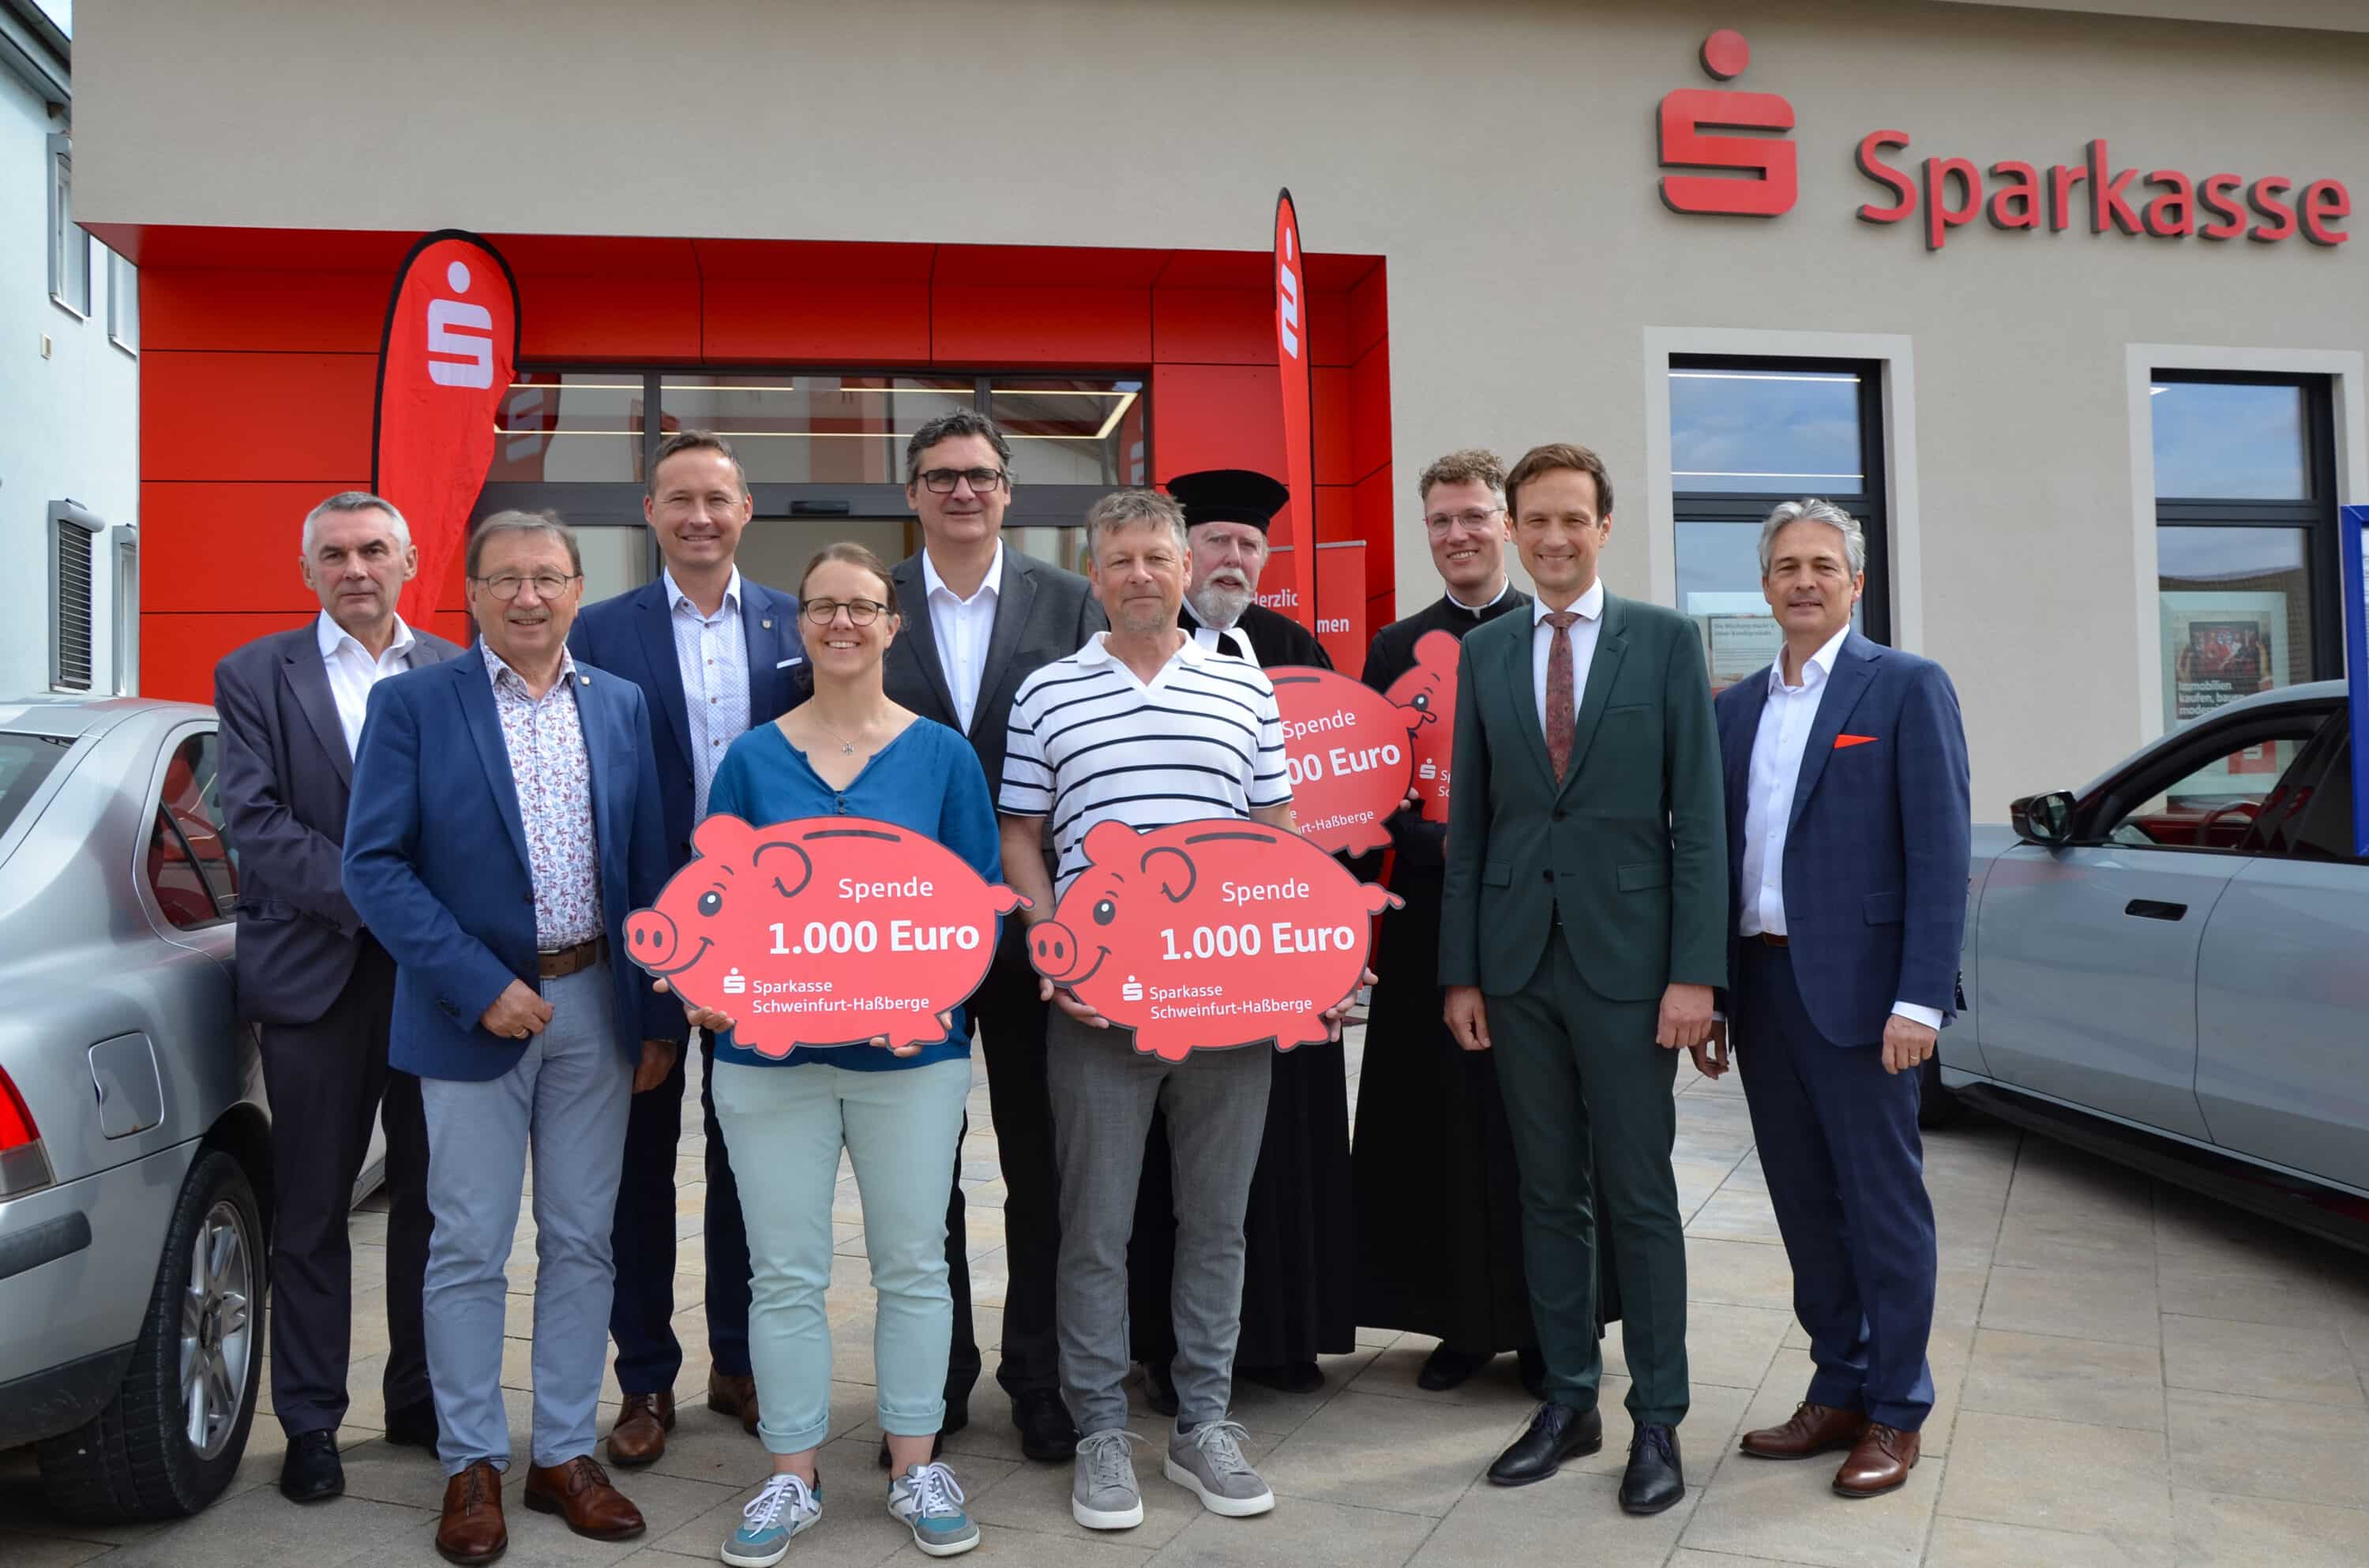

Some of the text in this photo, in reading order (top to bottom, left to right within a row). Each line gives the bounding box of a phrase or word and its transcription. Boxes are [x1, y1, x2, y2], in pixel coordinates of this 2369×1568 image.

[1856, 129, 2351, 252] Sparkasse
[2178, 680, 2232, 691] Immobilien
[1282, 709, 1357, 740] Spende
[1328, 745, 1401, 777] Euro
[838, 876, 933, 902] Spende
[1222, 878, 1310, 906] Spende
[768, 920, 980, 955] 1.000 Euro
[1160, 922, 1355, 960] 1.000 Euro
[753, 980, 833, 996] Sparkasse
[1149, 985, 1223, 1002] Sparkasse
[753, 996, 929, 1014] Schweinfurt-Haßberge
[1151, 999, 1312, 1020] Schweinfurt-Haßberge
